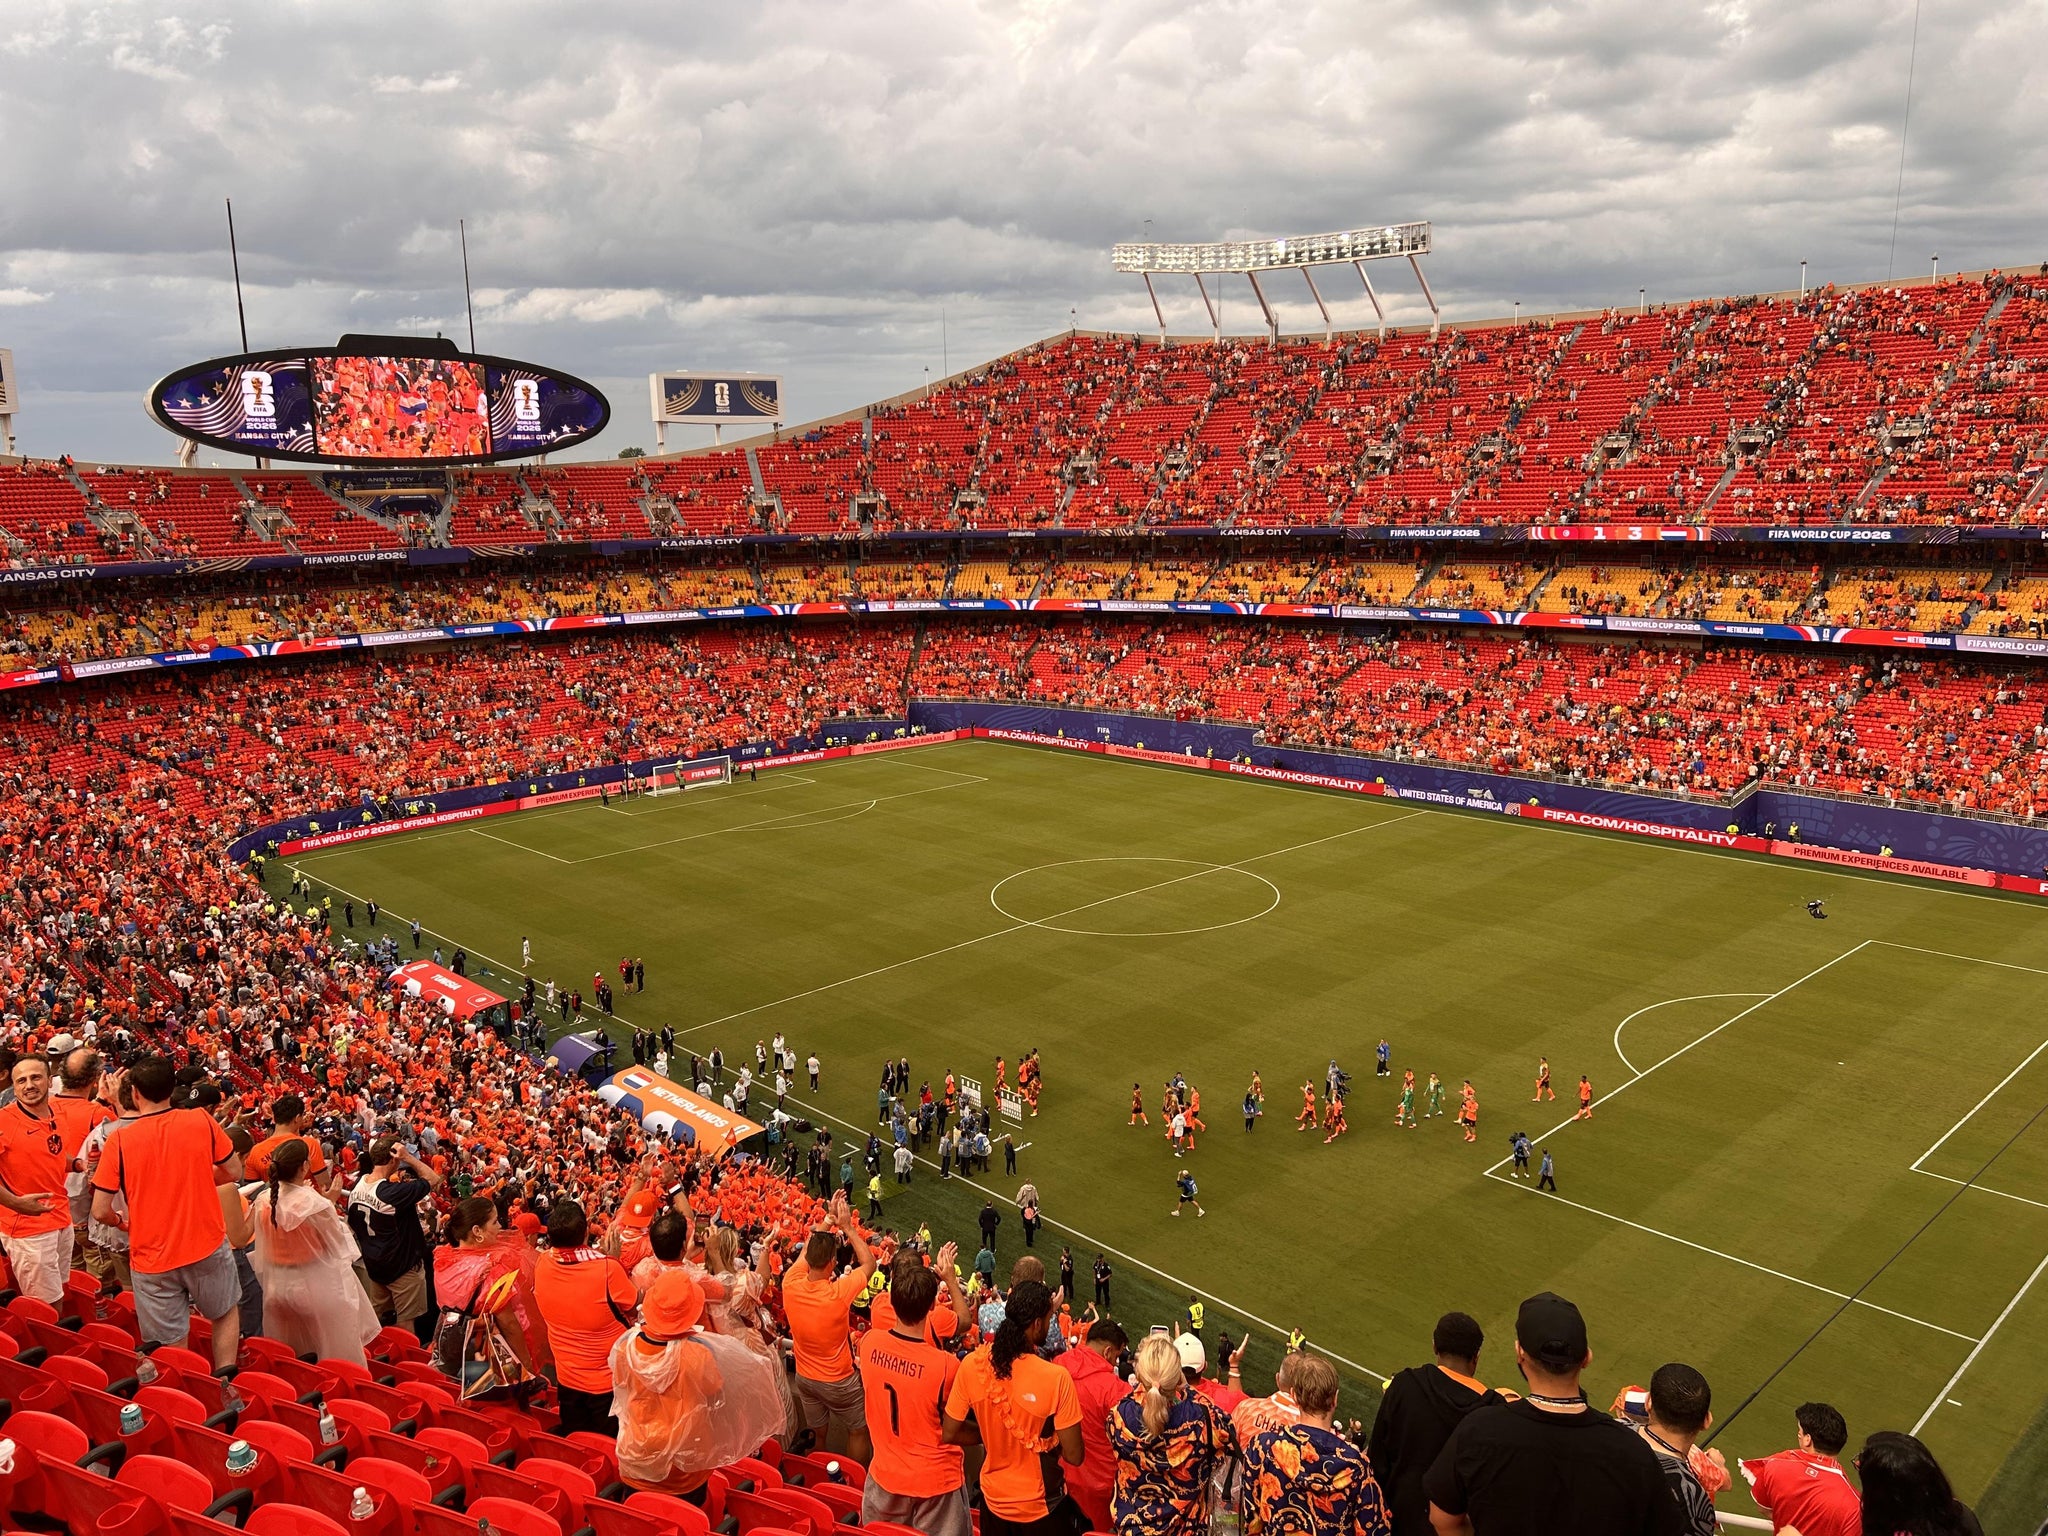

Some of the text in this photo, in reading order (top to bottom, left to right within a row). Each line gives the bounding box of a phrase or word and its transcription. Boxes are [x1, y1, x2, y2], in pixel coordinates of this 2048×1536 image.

[1593, 527, 1642, 540] 1 3
[1768, 531, 1891, 540] FIFA WORLD CUP 2026
[661, 539, 712, 547] KANSAS
[303, 552, 407, 565] FIFA WORLD CUP 2026
[60, 568, 96, 578] CITY
[678, 611, 698, 619] 2026
[1631, 621, 1658, 629] WORLD
[1659, 622, 1673, 630] CUP
[1674, 623, 1700, 631] 2026
[369, 635, 383, 643] FIFA
[421, 630, 444, 638] 2026
[1907, 636, 1951, 646] NETHERLANDS
[1967, 639, 1988, 648] FIFA
[1989, 640, 2025, 650] WORLD
[2025, 642, 2045, 651] CUP
[85, 664, 111, 673] WORLD
[112, 662, 126, 670] CUP
[126, 659, 152, 668] 2026
[988, 729, 1089, 749] FIFA.COM/HOSPITALITY
[742, 747, 756, 755] FIFA
[691, 770, 705, 779] FIFA
[765, 757, 789, 766] OFFICIAL
[790, 752, 824, 763] HOSPITALITY
[1229, 764, 1365, 791] FIFA.COM/HOSPITALITY
[405, 800, 424, 809] FIFA
[536, 793, 567, 805] PREMIUM
[1400, 788, 1503, 812] UNITED STATES OF AMERICA
[302, 808, 484, 849] FIFA WORLD CUP 2026: OFFICIAL HOSPITALITY
[1543, 809, 1737, 846] FIFA.COM/HOSPITALITY
[1793, 847, 1968, 881] PREMIUM EXPERIENCES AVAILABLE
[649, 1086, 729, 1128] NETHERLANDS
[357, 1204, 376, 1236] 7
[883, 1382, 900, 1437] 1
